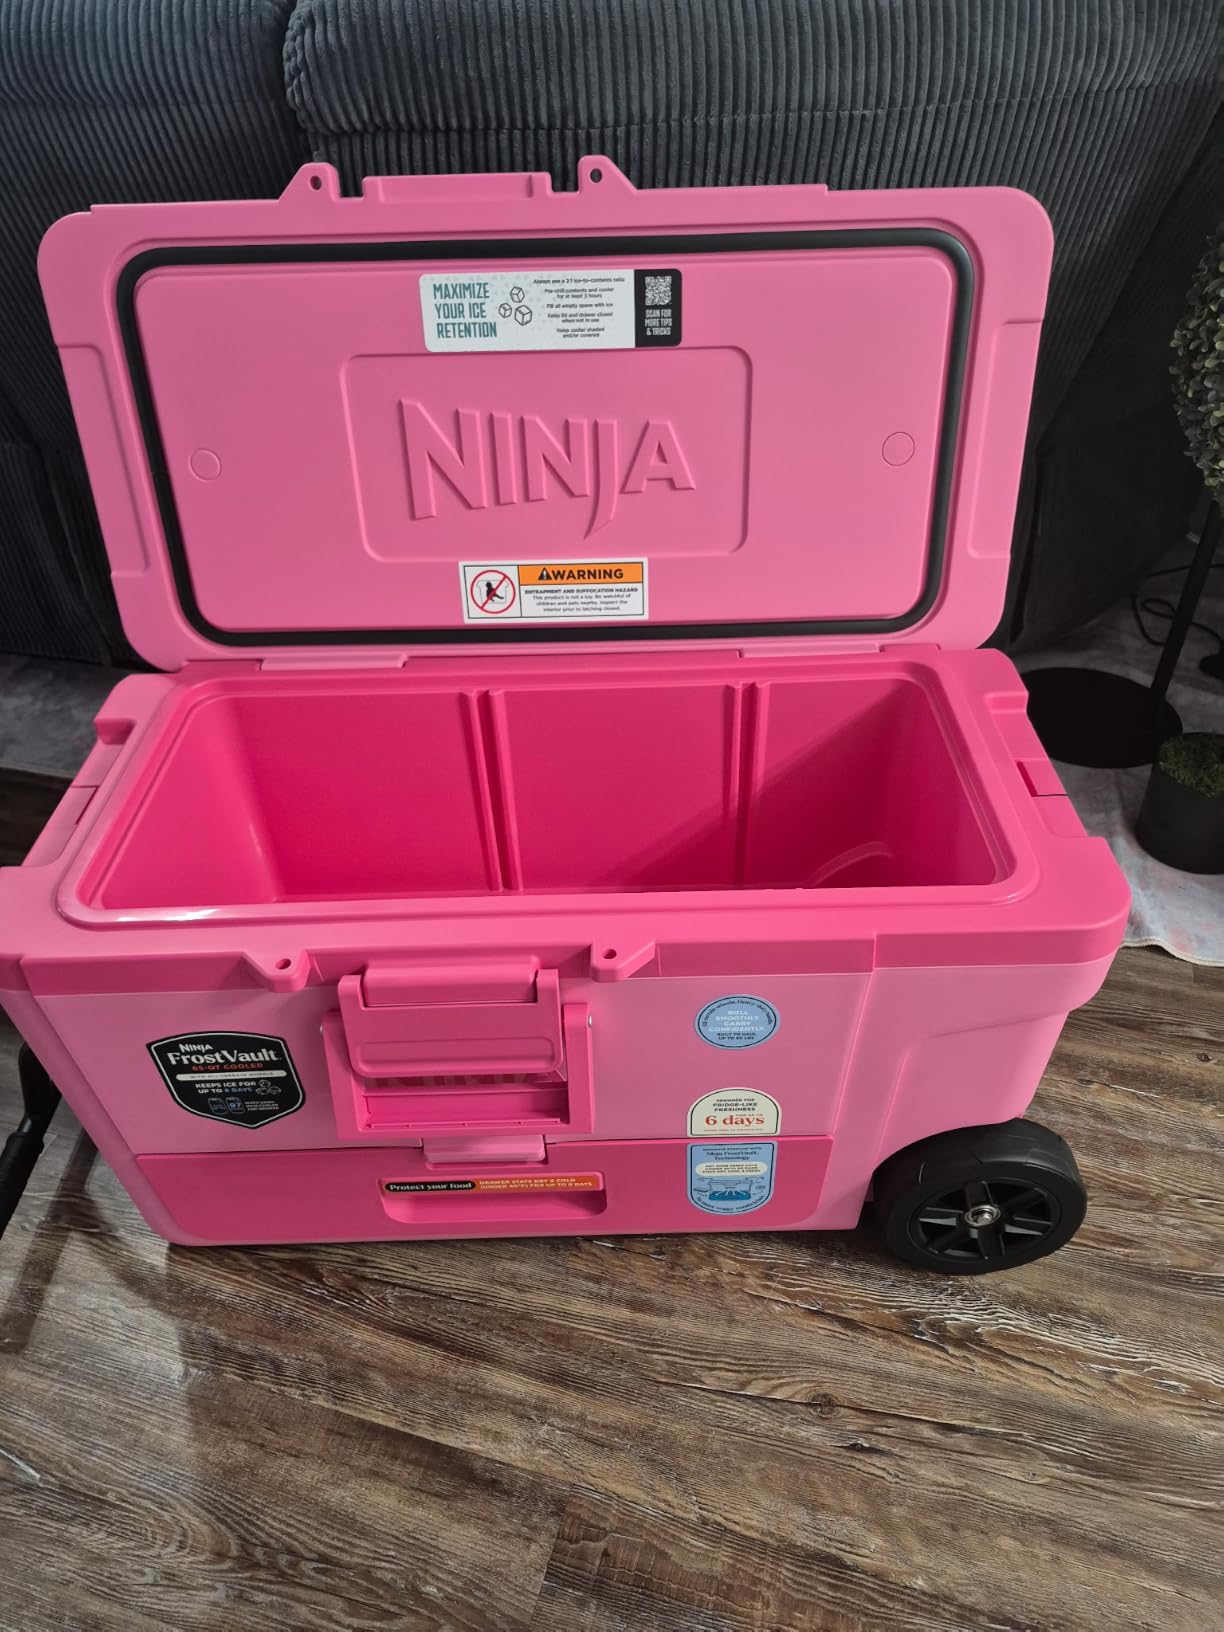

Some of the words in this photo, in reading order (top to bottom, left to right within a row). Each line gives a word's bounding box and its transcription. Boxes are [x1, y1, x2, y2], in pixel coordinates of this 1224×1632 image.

[433, 283, 489, 299] MAXIMIZE
[435, 303, 465, 319] YOUR
[469, 302, 487, 318] ICE
[645, 309, 660, 318] SCAN
[661, 309, 672, 317] FOR
[645, 318, 660, 327] MORE
[661, 318, 672, 326] TIPS
[436, 322, 497, 339] RETENTION
[399, 398, 696, 539] NINJA
[552, 568, 624, 580] WARNING
[179, 1044, 213, 1053] NINJA
[167, 1048, 279, 1065] FrostVault
[705, 1115, 717, 1125] 6
[722, 1115, 765, 1126] days
